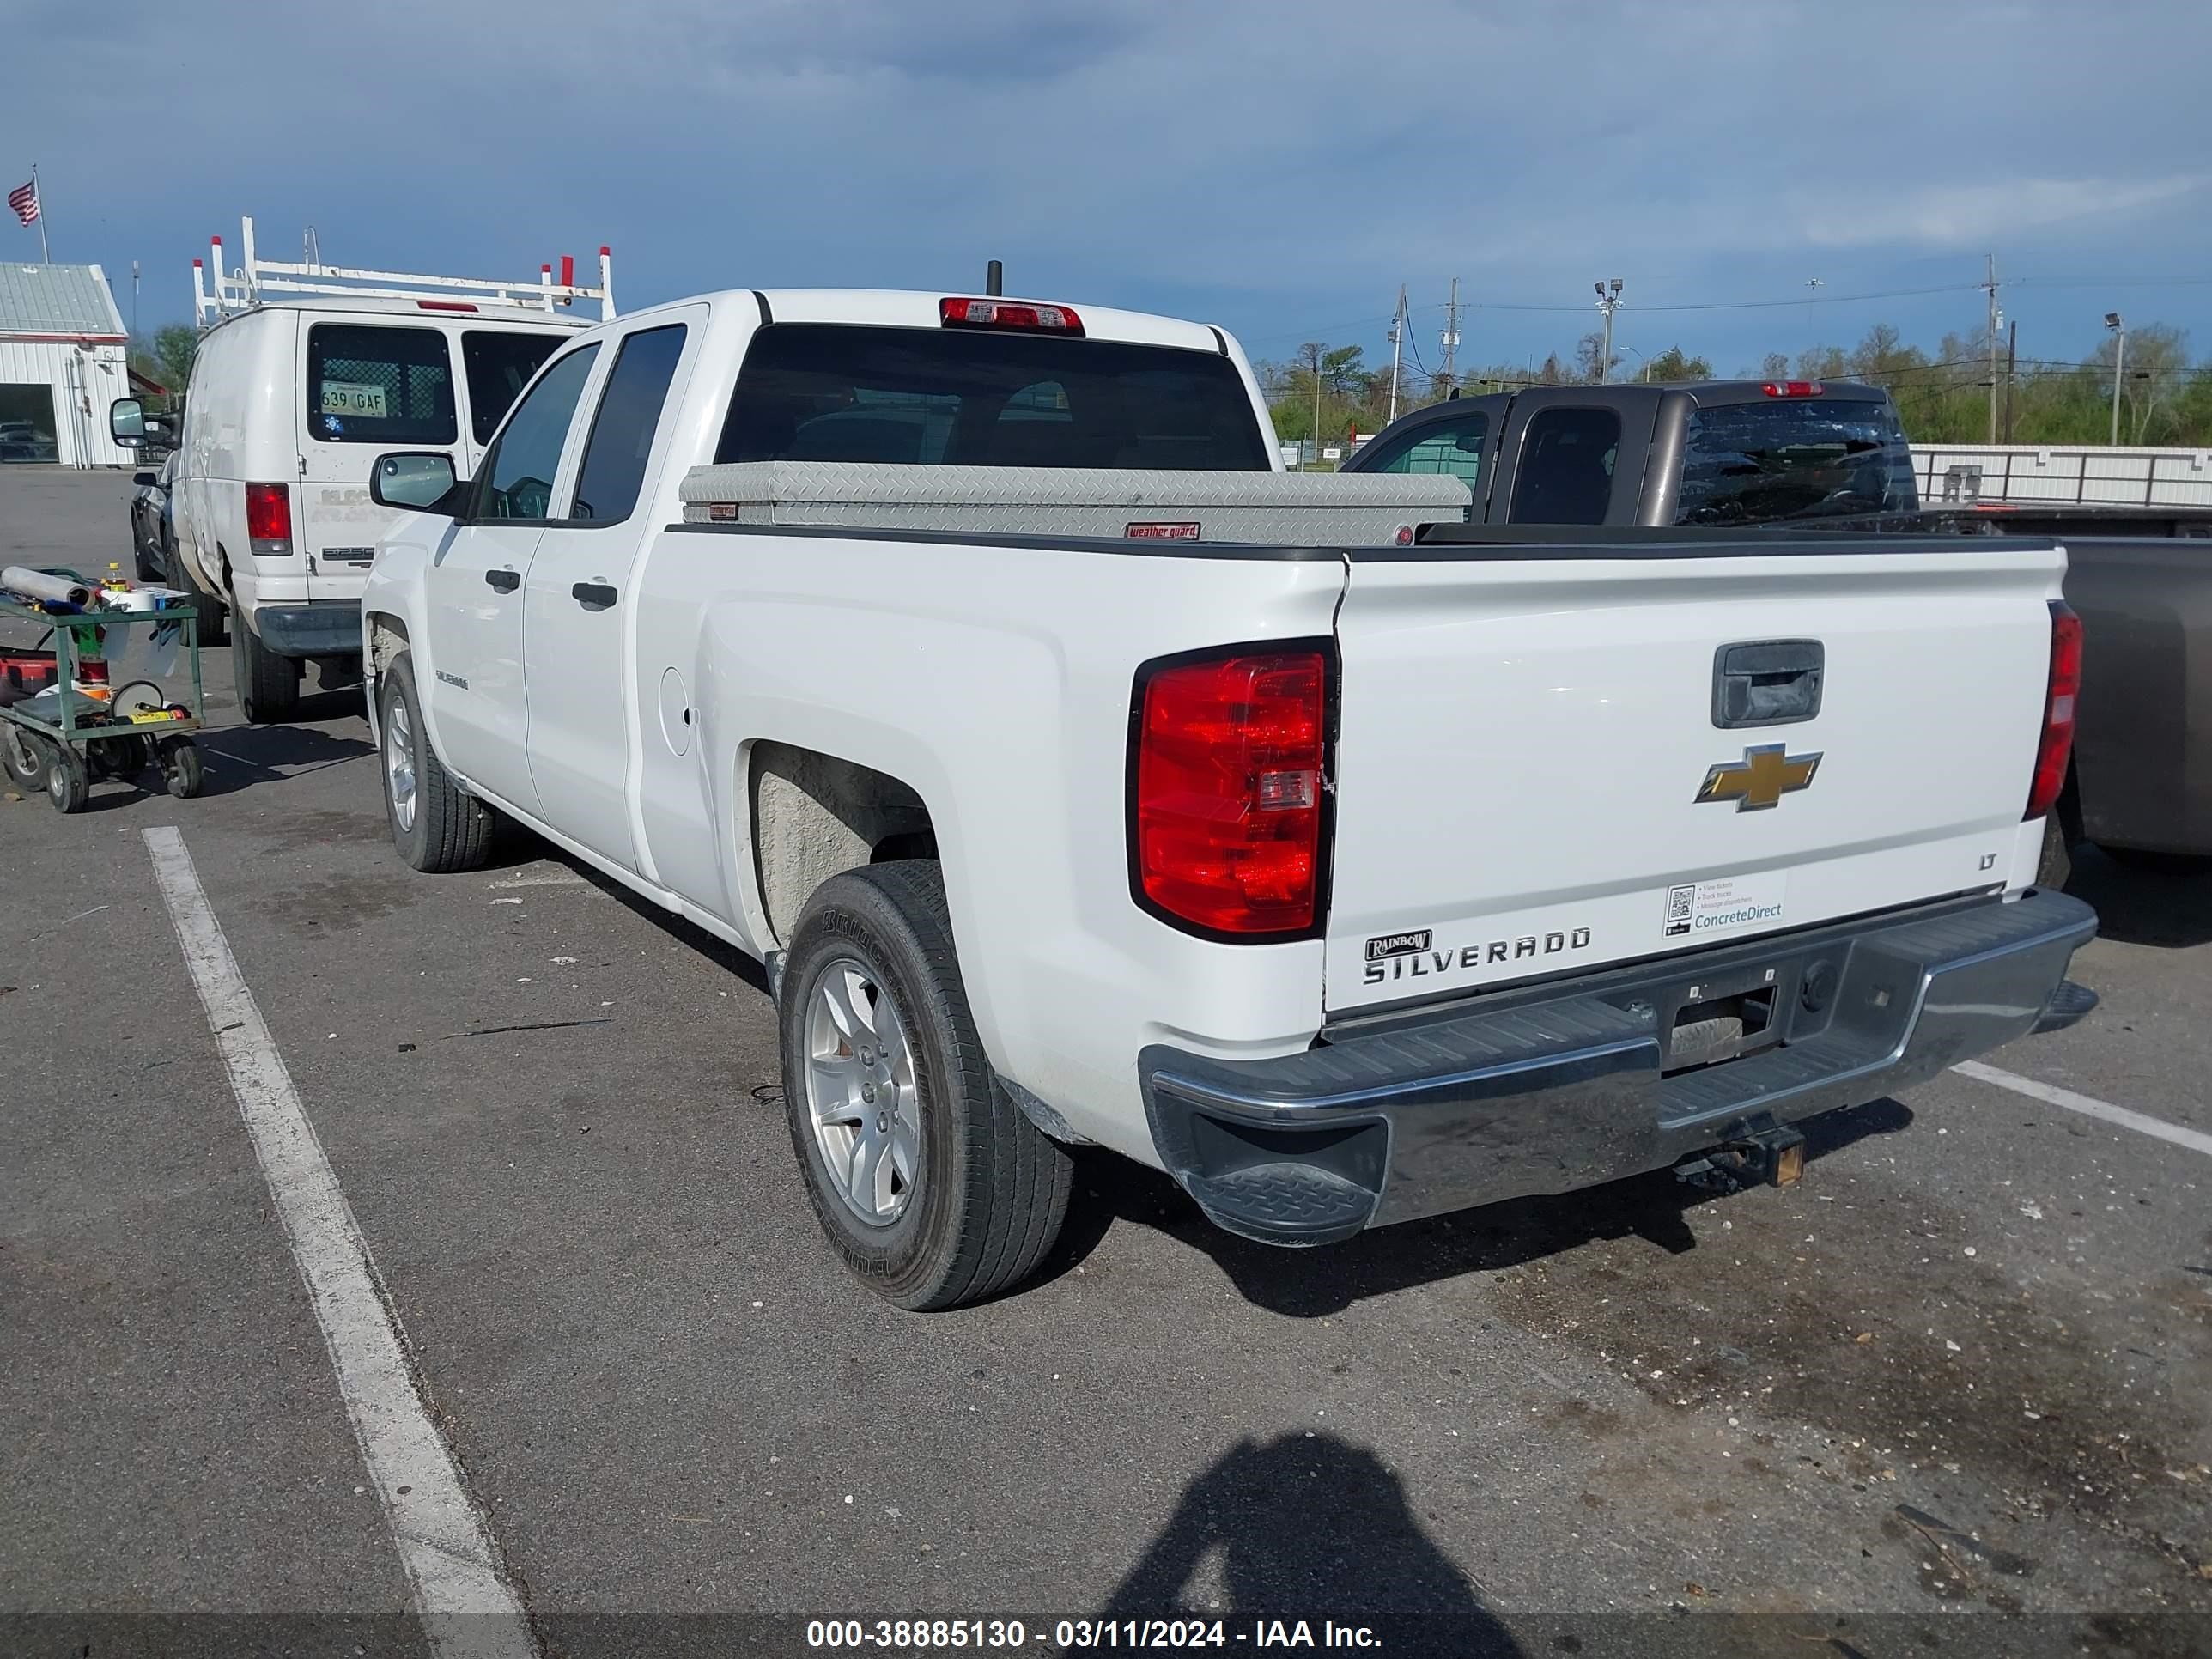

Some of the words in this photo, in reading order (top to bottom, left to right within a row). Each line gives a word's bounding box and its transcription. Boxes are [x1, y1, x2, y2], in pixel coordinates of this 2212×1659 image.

[322, 392, 347, 407] 639
[356, 393, 382, 410] GAF
[1129, 526, 1169, 538] weather
[1170, 526, 1196, 538] guard
[1978, 853, 1997, 871] LT
[1695, 902, 1782, 928] ConcreteDirect
[1374, 931, 1427, 957] RAINBOW
[1363, 927, 1590, 985] SILVERADO
